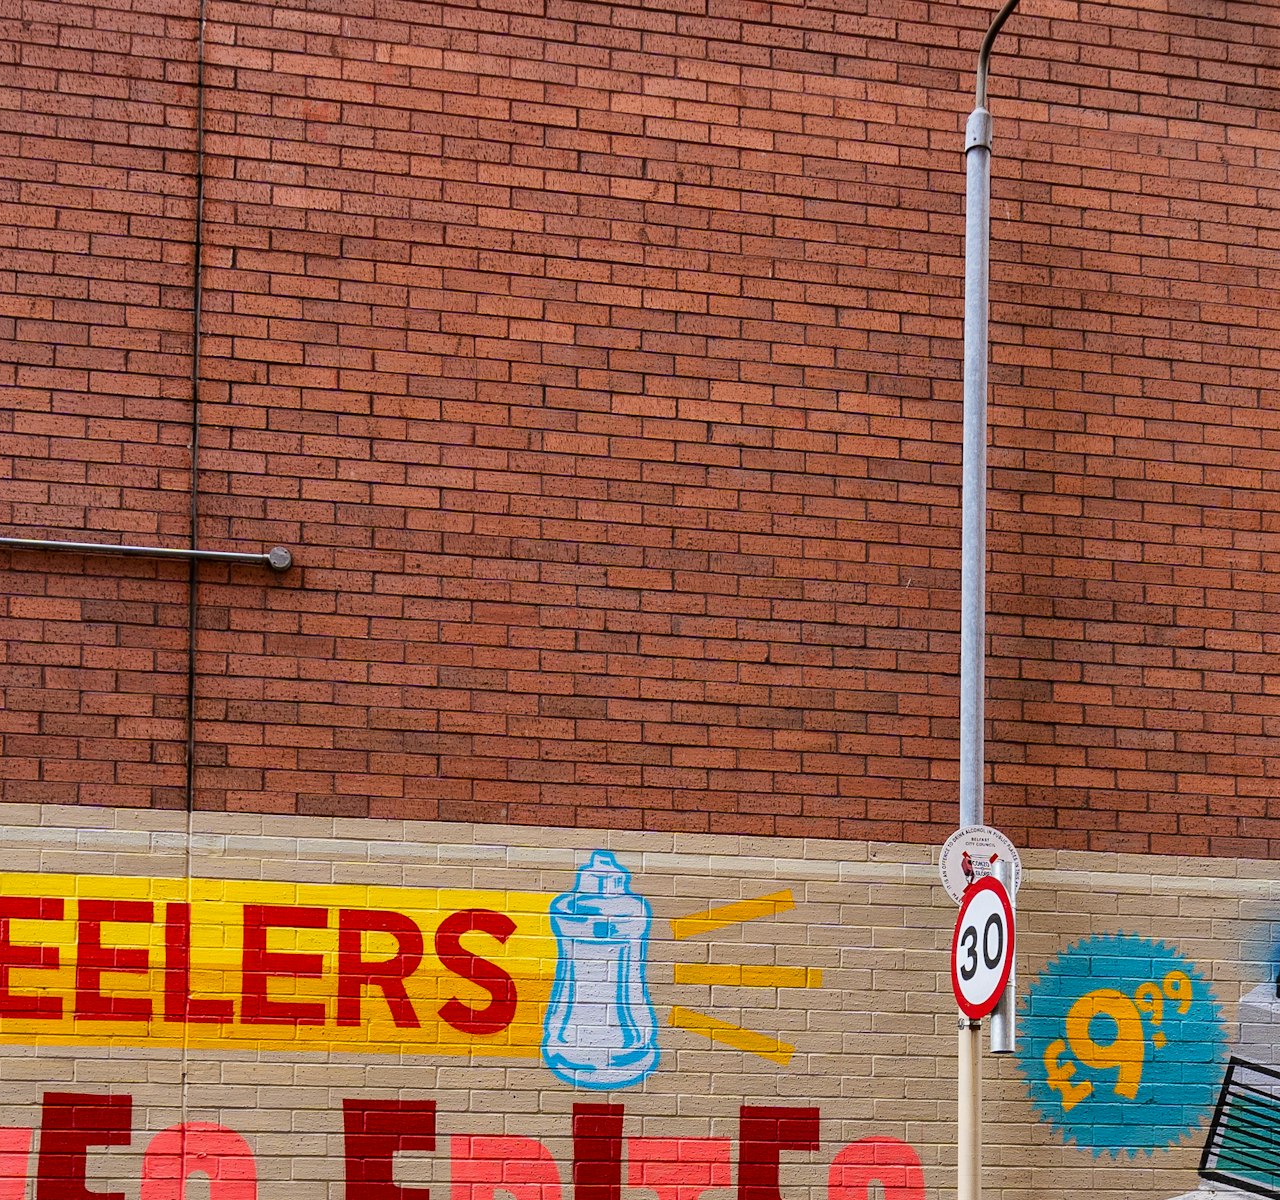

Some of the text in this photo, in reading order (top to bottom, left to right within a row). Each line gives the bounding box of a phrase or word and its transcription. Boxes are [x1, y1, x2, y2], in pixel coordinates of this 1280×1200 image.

[952, 831, 965, 843] DRINK
[965, 827, 986, 835] ALCOHOL
[992, 832, 1008, 845] PUBLIC
[960, 913, 1004, 981] 30
